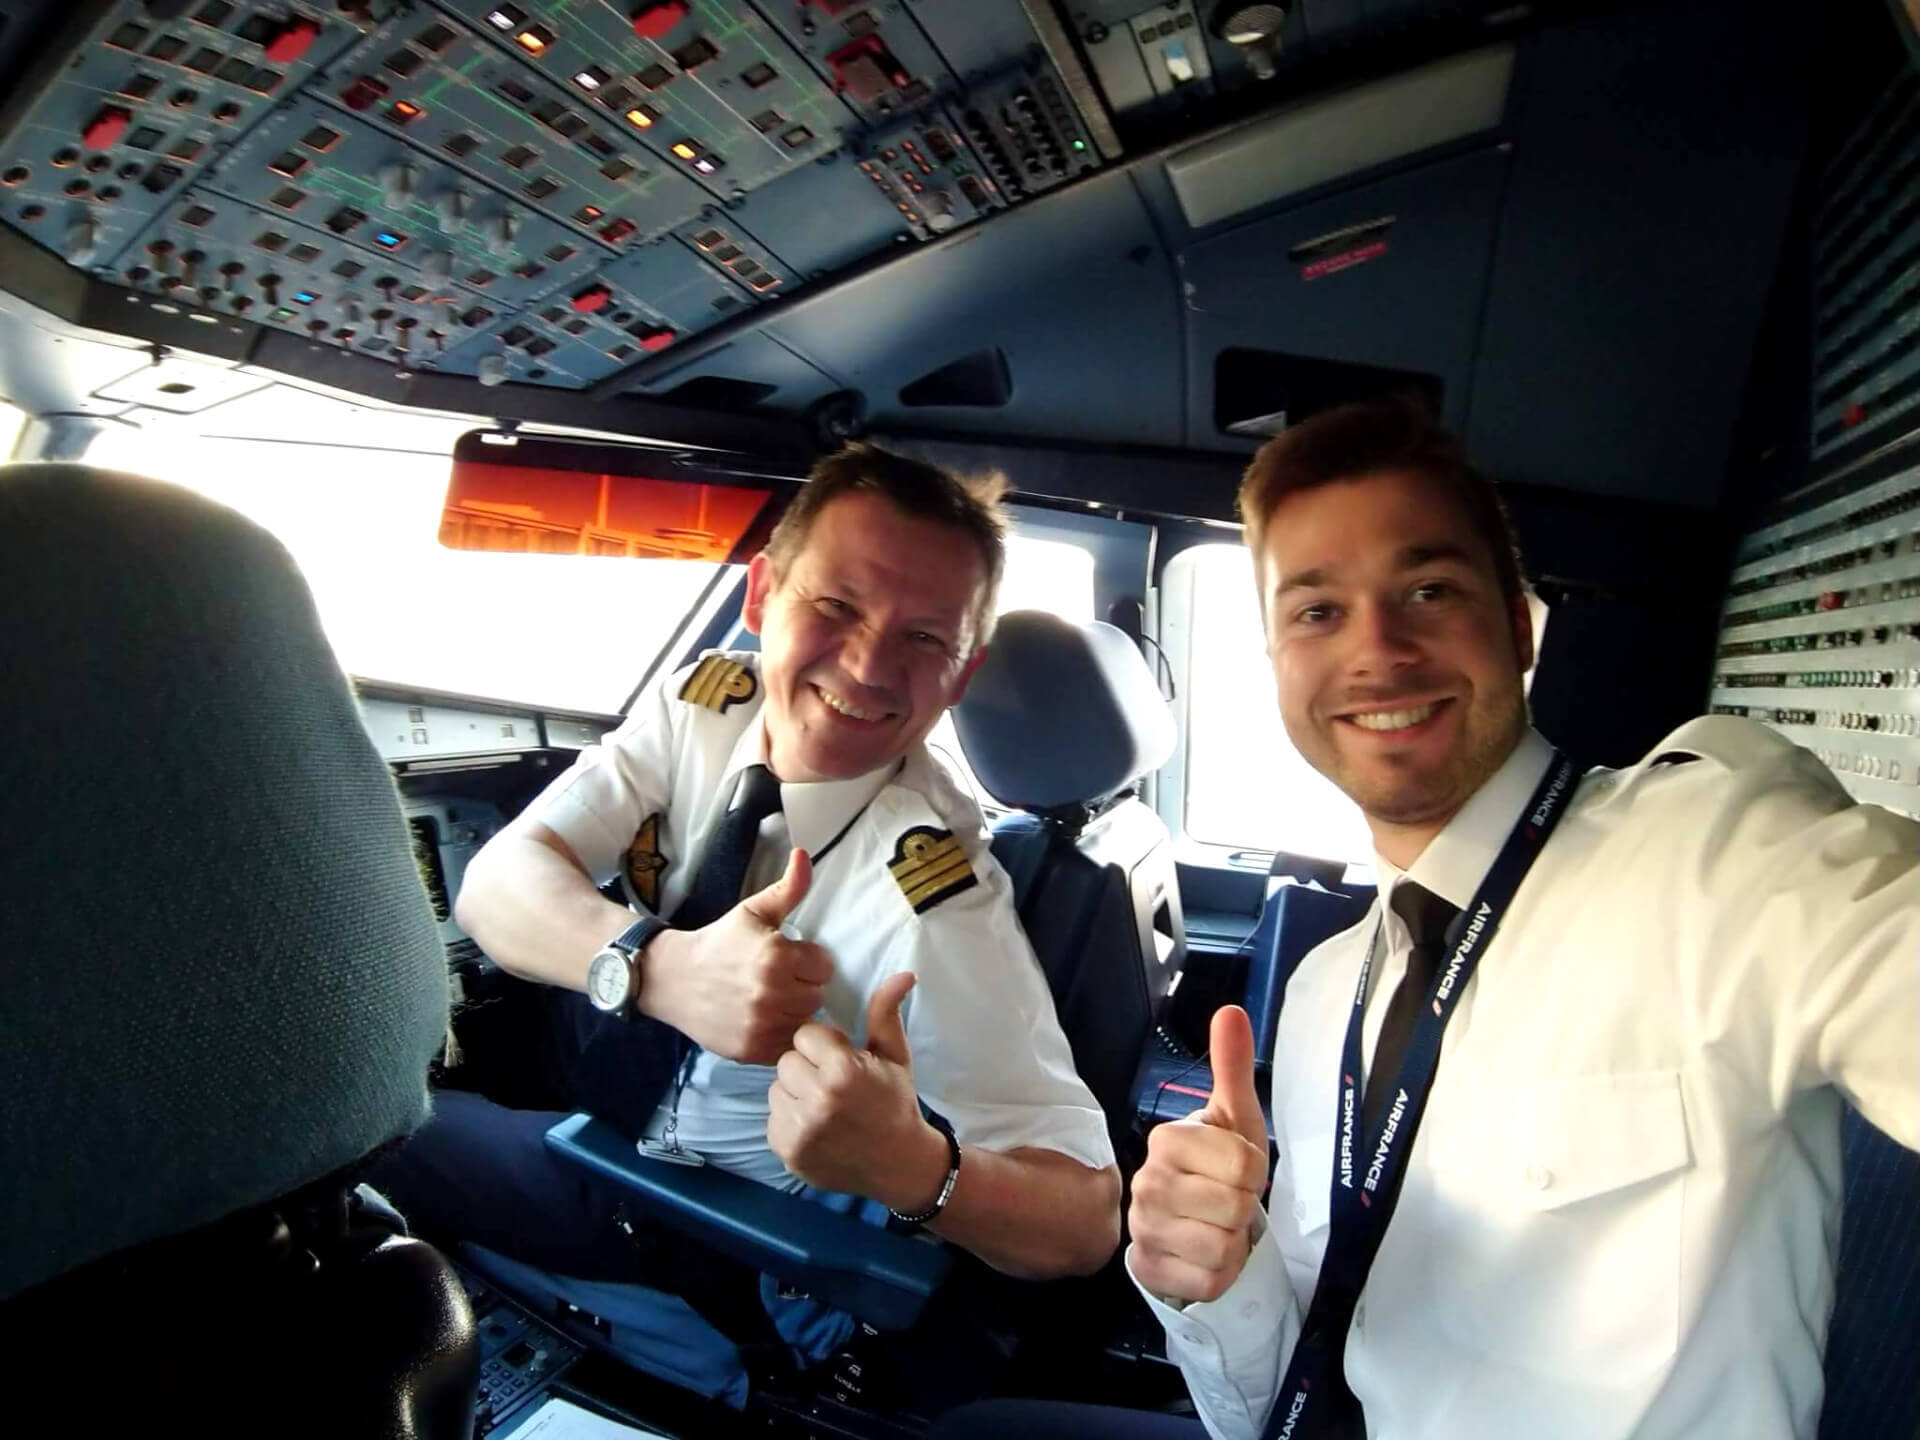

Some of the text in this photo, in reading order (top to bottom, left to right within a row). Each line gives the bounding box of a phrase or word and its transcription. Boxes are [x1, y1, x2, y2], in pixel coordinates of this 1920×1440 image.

[1531, 761, 1572, 827] RFRANCE
[1436, 901, 1493, 1000] AIRFRANCE
[1341, 1088, 1354, 1189] AIRFRANCE
[1364, 1087, 1409, 1192] AIRFRANCE
